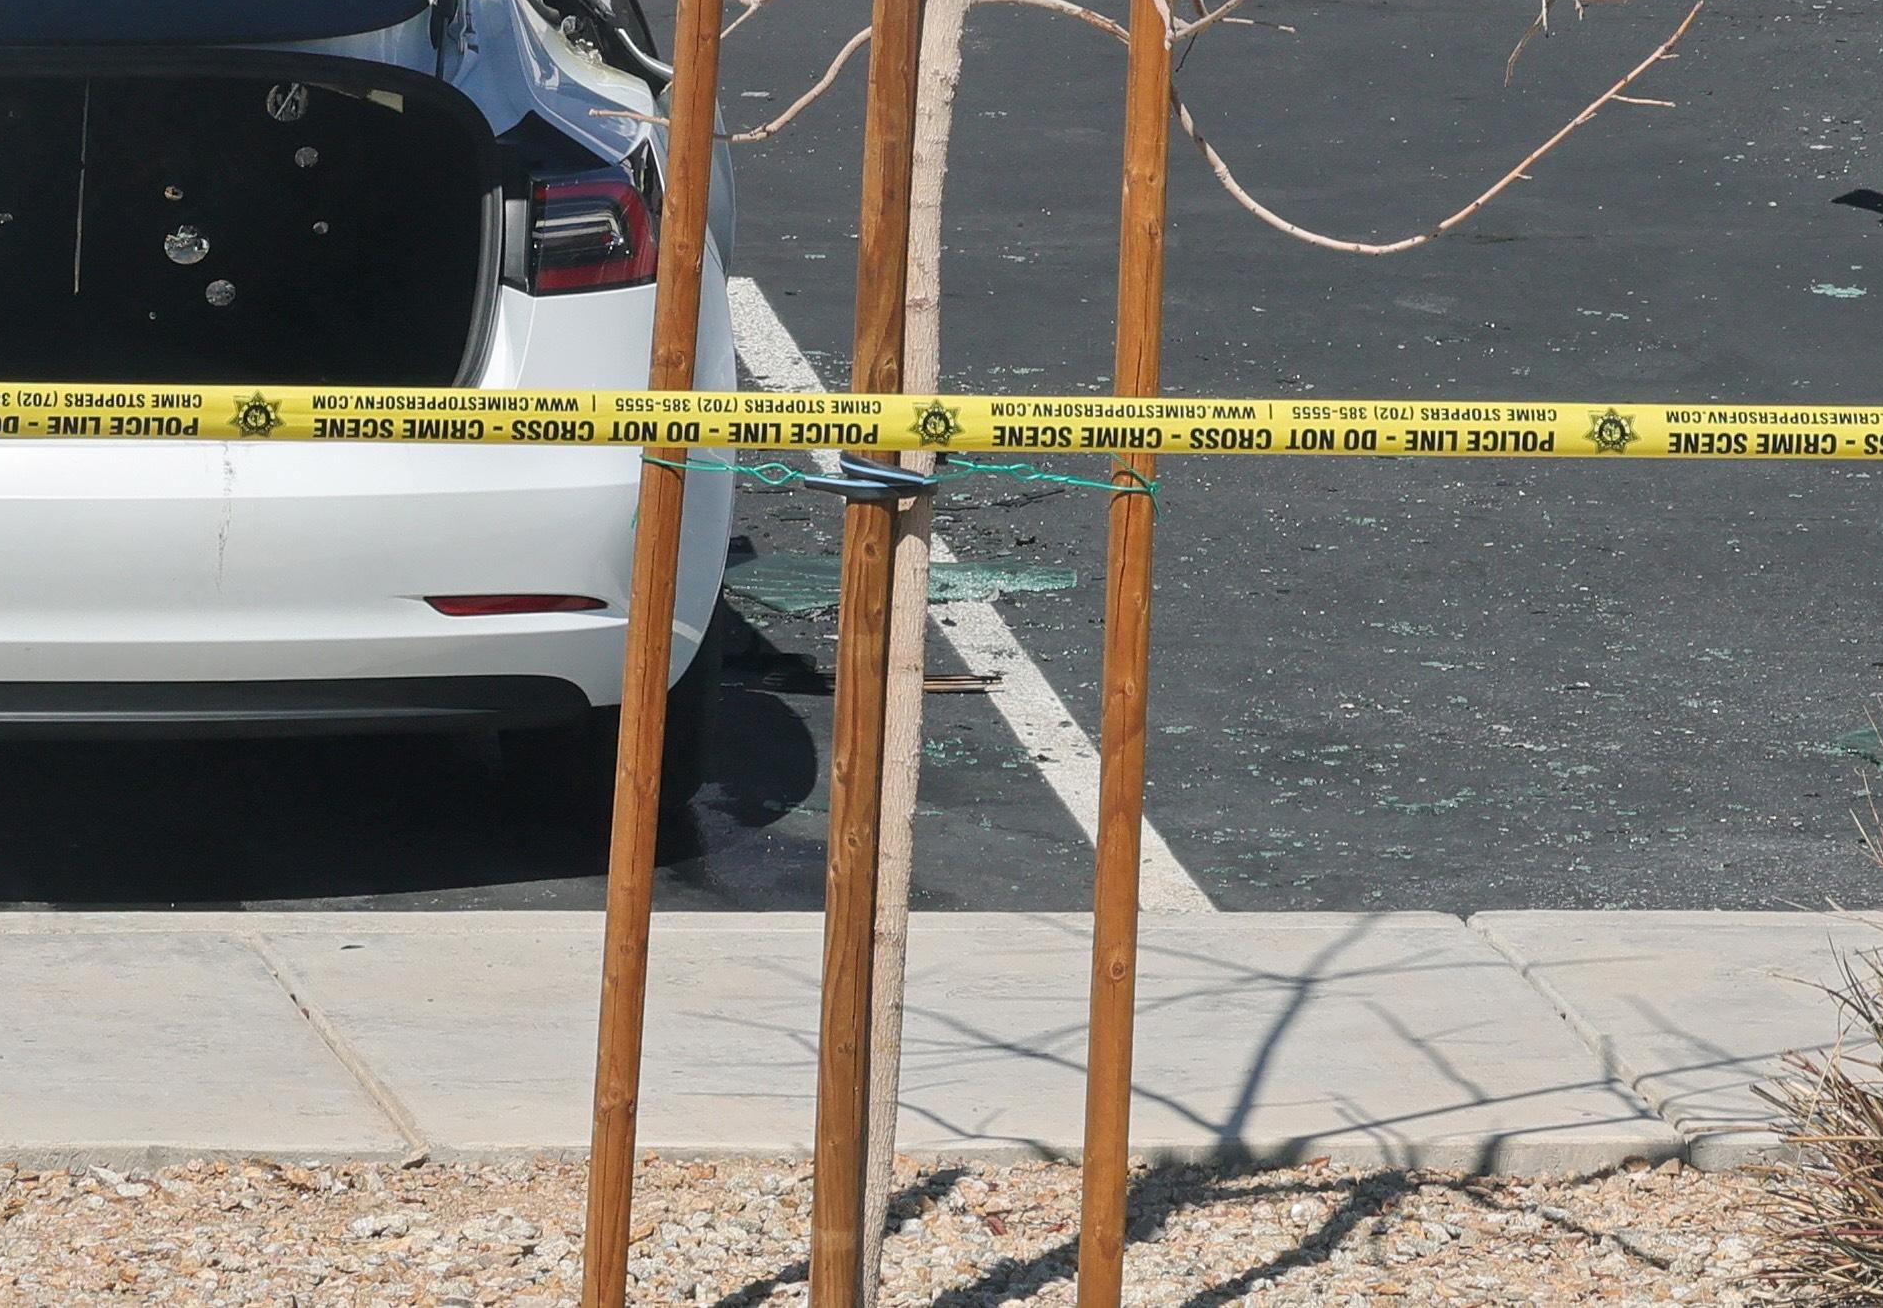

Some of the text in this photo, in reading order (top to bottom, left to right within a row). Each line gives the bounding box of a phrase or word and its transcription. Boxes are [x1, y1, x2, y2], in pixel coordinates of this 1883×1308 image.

[16, 390, 58, 408] (702)
[64, 392, 146, 409] STOPPERS
[151, 393, 203, 409] CRIME
[312, 395, 882, 415] CRIME STOPPERS (702) 385-5555 WWW.CRIMESTOPPERSOFNV.COM
[991, 402, 1557, 422] CRIME STOPPERS (702) 385-5555 WWW.CRIMESTOPPERSOFNV.COM
[46, 416, 101, 435] LINE
[108, 416, 199, 436] POLICE
[312, 418, 879, 445] POLICE LINE DO NOT CROSS CRIME SCENE
[991, 425, 1555, 453] POLICE LINE DO NOT CROSS CRIME SCENE
[1667, 432, 1748, 455] SCENE
[1755, 433, 1837, 455] CRIME
